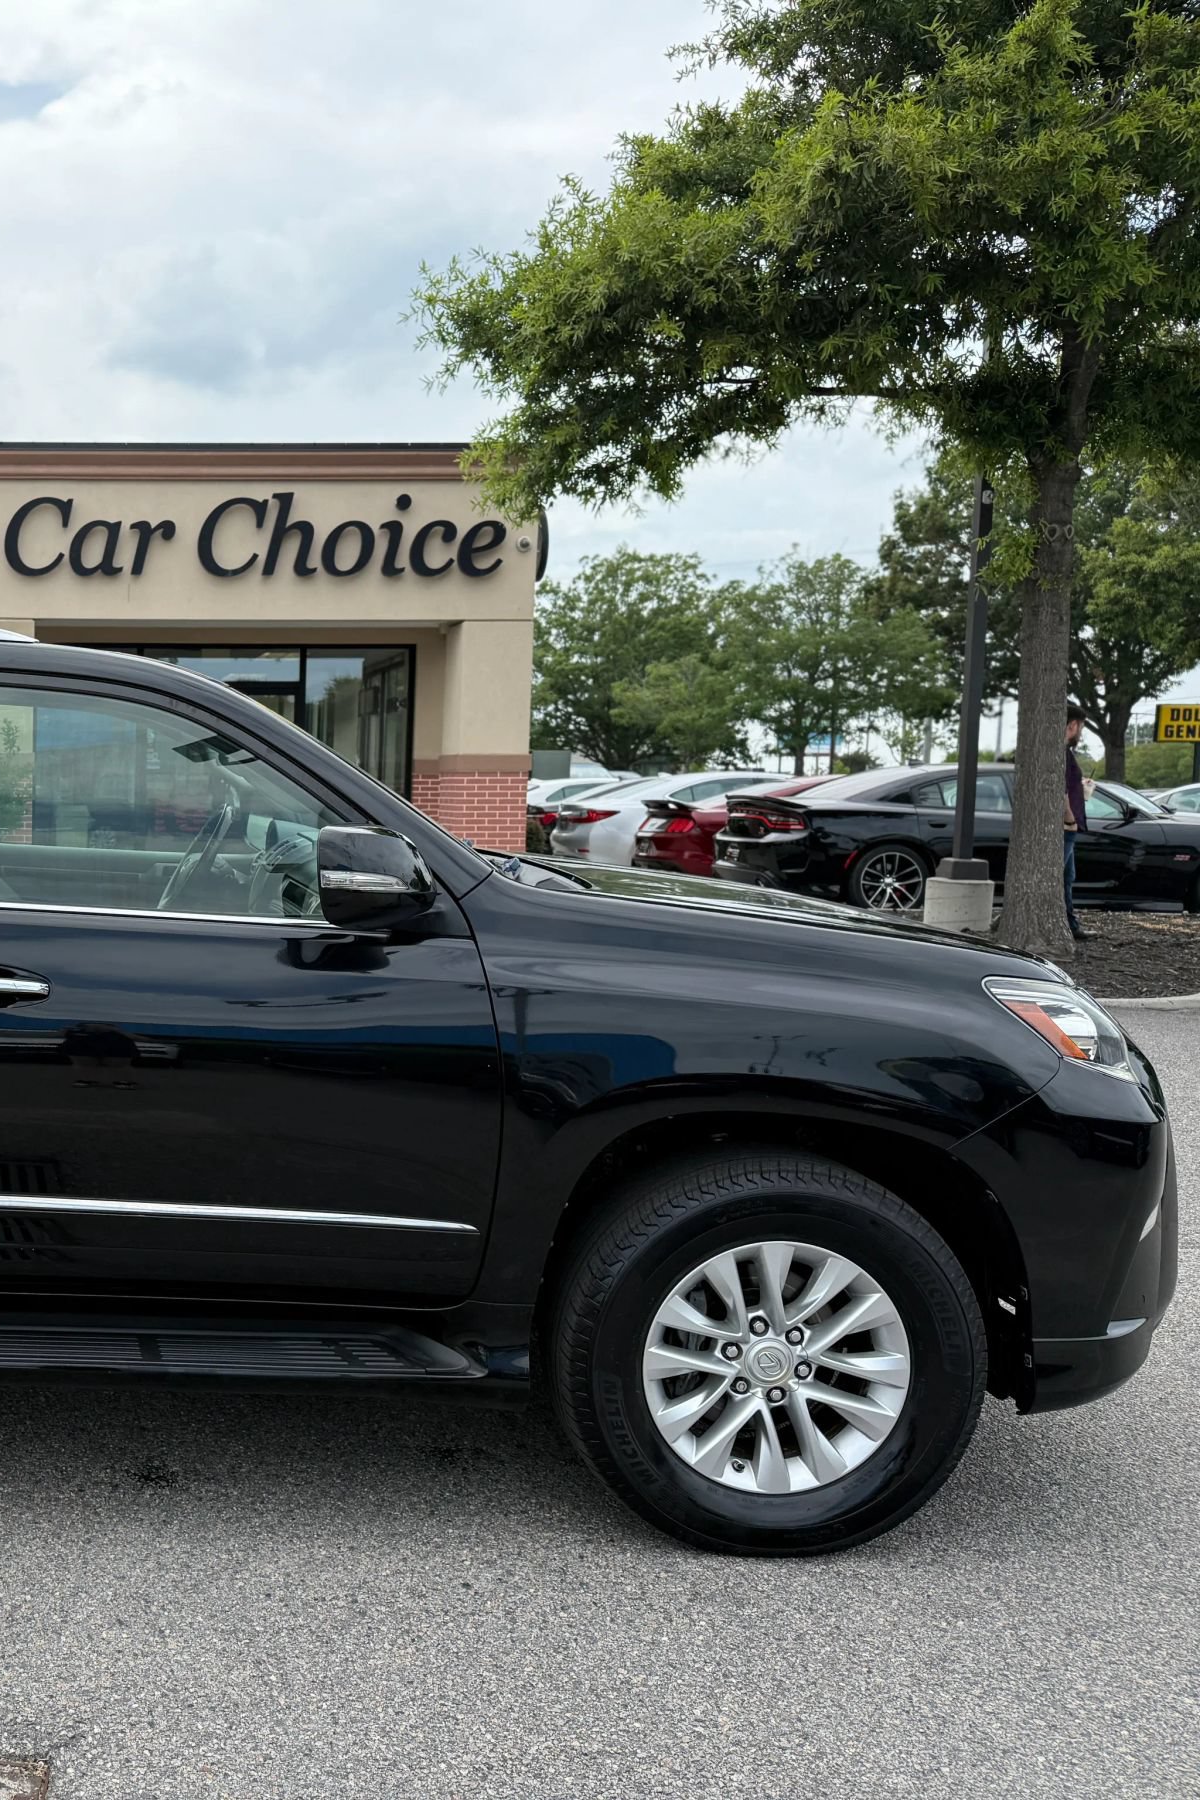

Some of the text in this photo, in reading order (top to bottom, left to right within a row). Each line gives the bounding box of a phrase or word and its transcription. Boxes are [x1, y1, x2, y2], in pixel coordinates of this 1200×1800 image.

[4, 492, 507, 578] Car Choice
[1164, 724, 1200, 738] GEN
[909, 1260, 961, 1365] MICHELIN
[603, 1379, 660, 1486] MICHELIN
